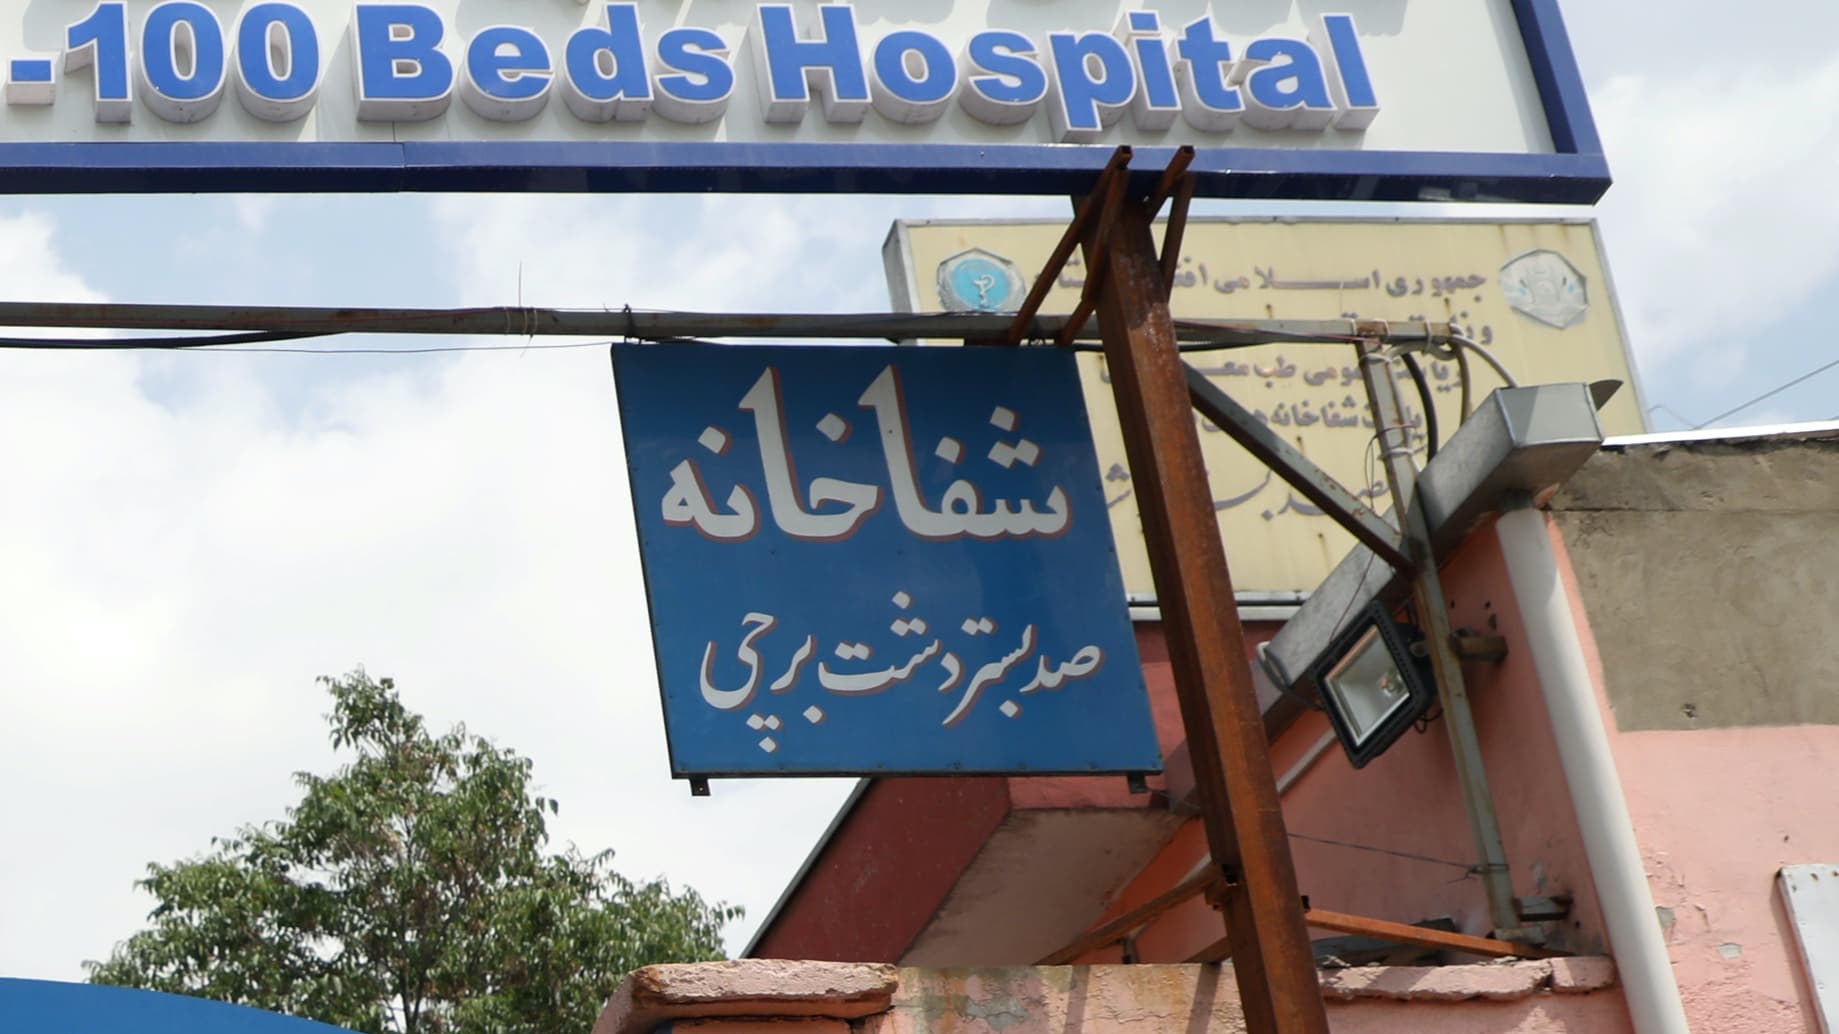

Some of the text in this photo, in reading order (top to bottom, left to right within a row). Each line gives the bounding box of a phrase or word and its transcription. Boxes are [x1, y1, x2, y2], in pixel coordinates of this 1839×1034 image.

[356, 4, 734, 102] Beds
[760, 5, 1376, 129] Hospital
[1214, 264, 1381, 295] اسلامی
[661, 364, 1074, 540] شفاخانه
[698, 590, 1103, 753] صد بستر دشت برچی
